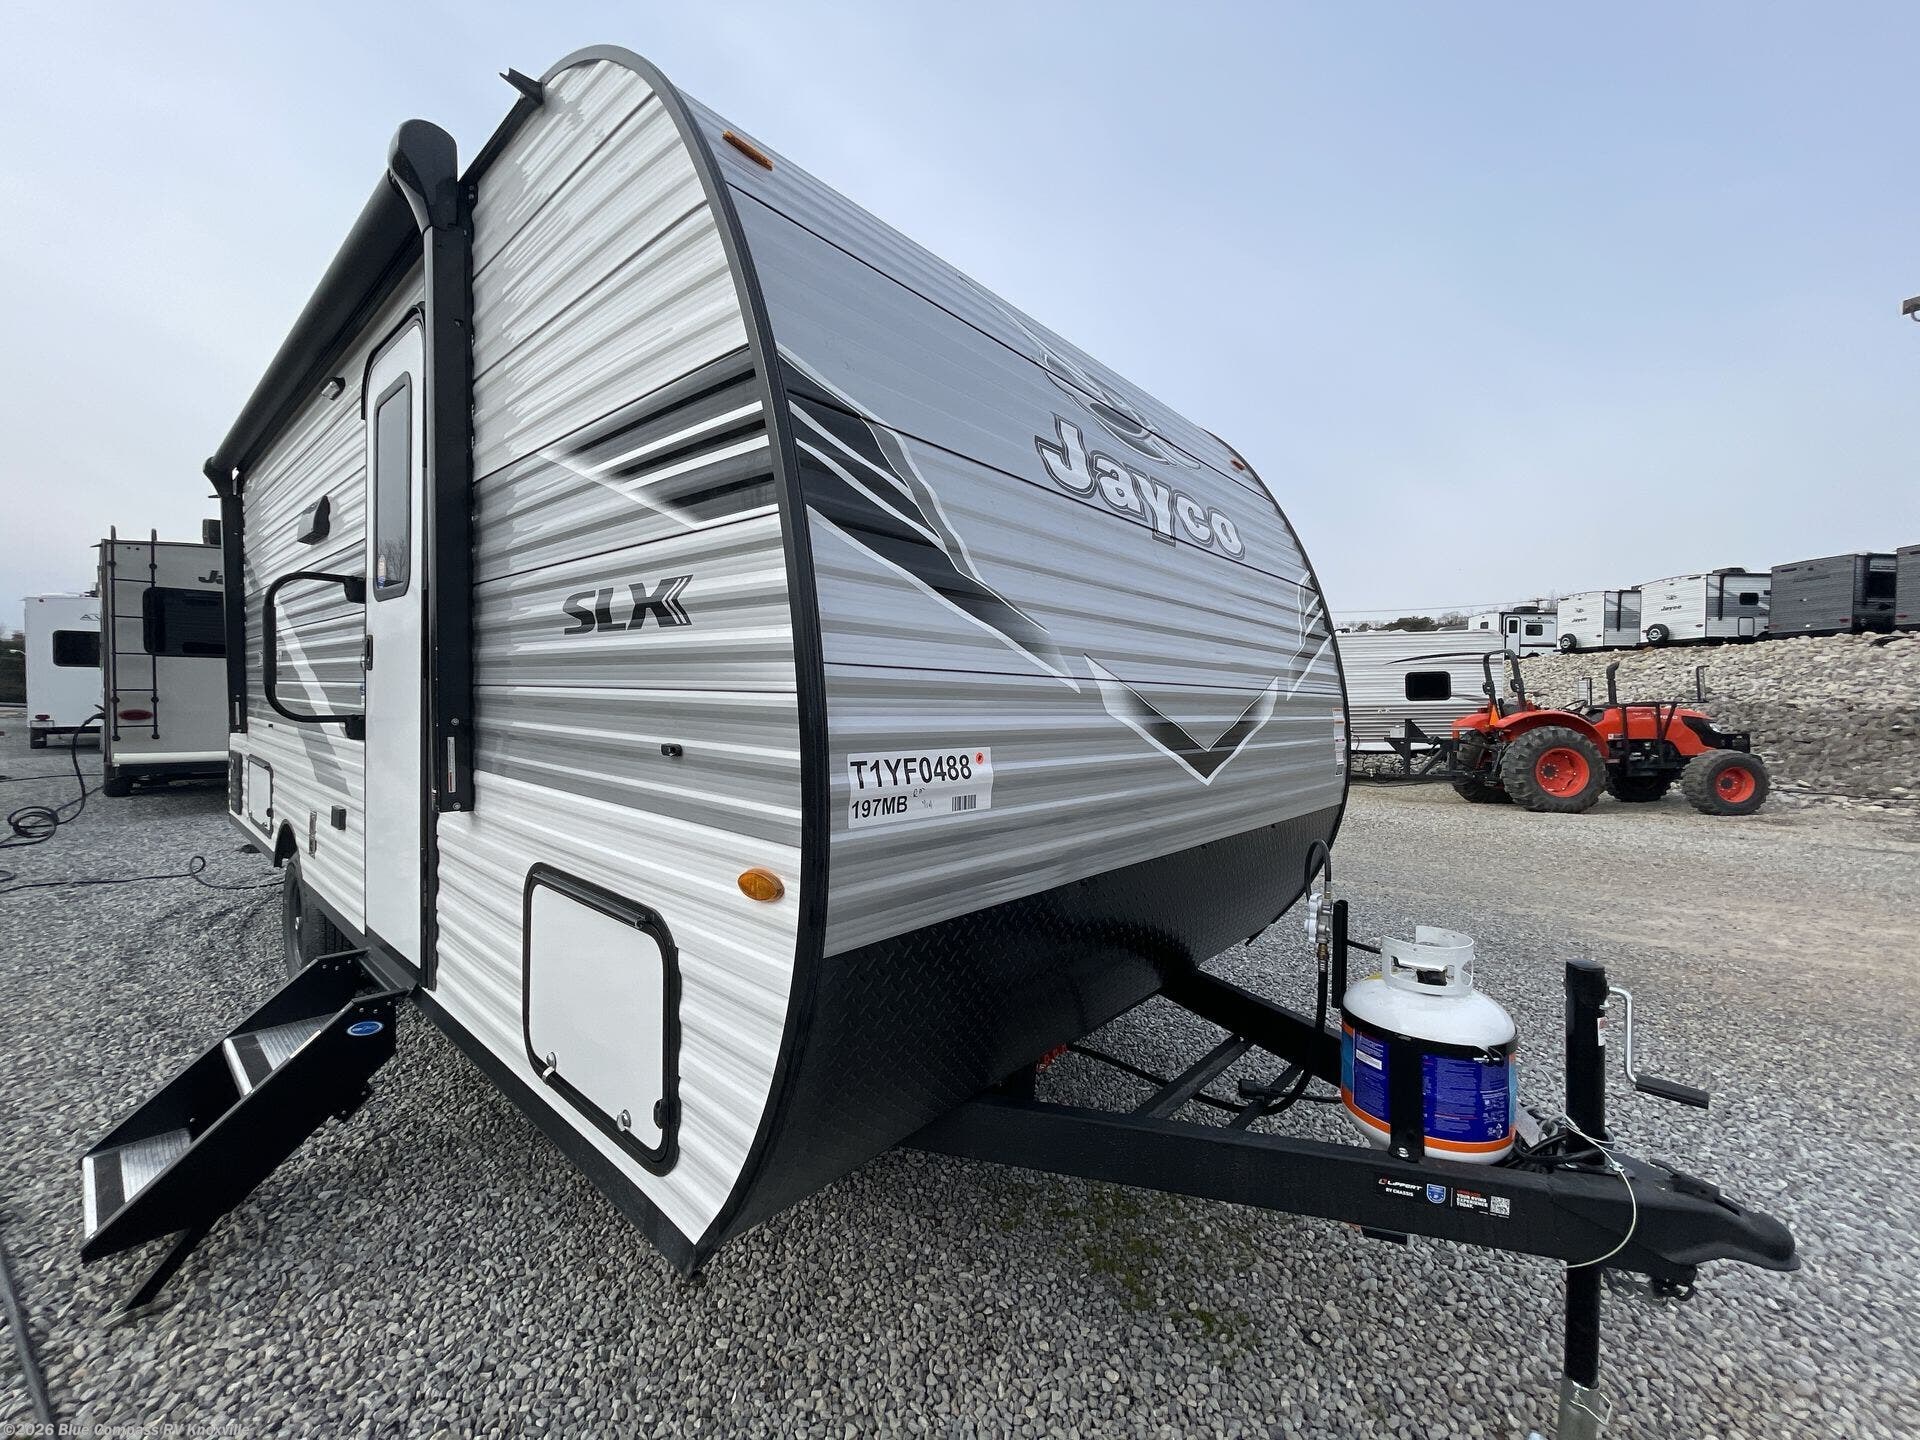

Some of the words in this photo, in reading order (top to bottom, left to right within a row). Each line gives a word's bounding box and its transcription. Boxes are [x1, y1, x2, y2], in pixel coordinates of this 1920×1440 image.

[1034, 412, 1246, 561] Jayco
[850, 754, 973, 790] T1YF0488
[851, 795, 908, 819] 197MB
